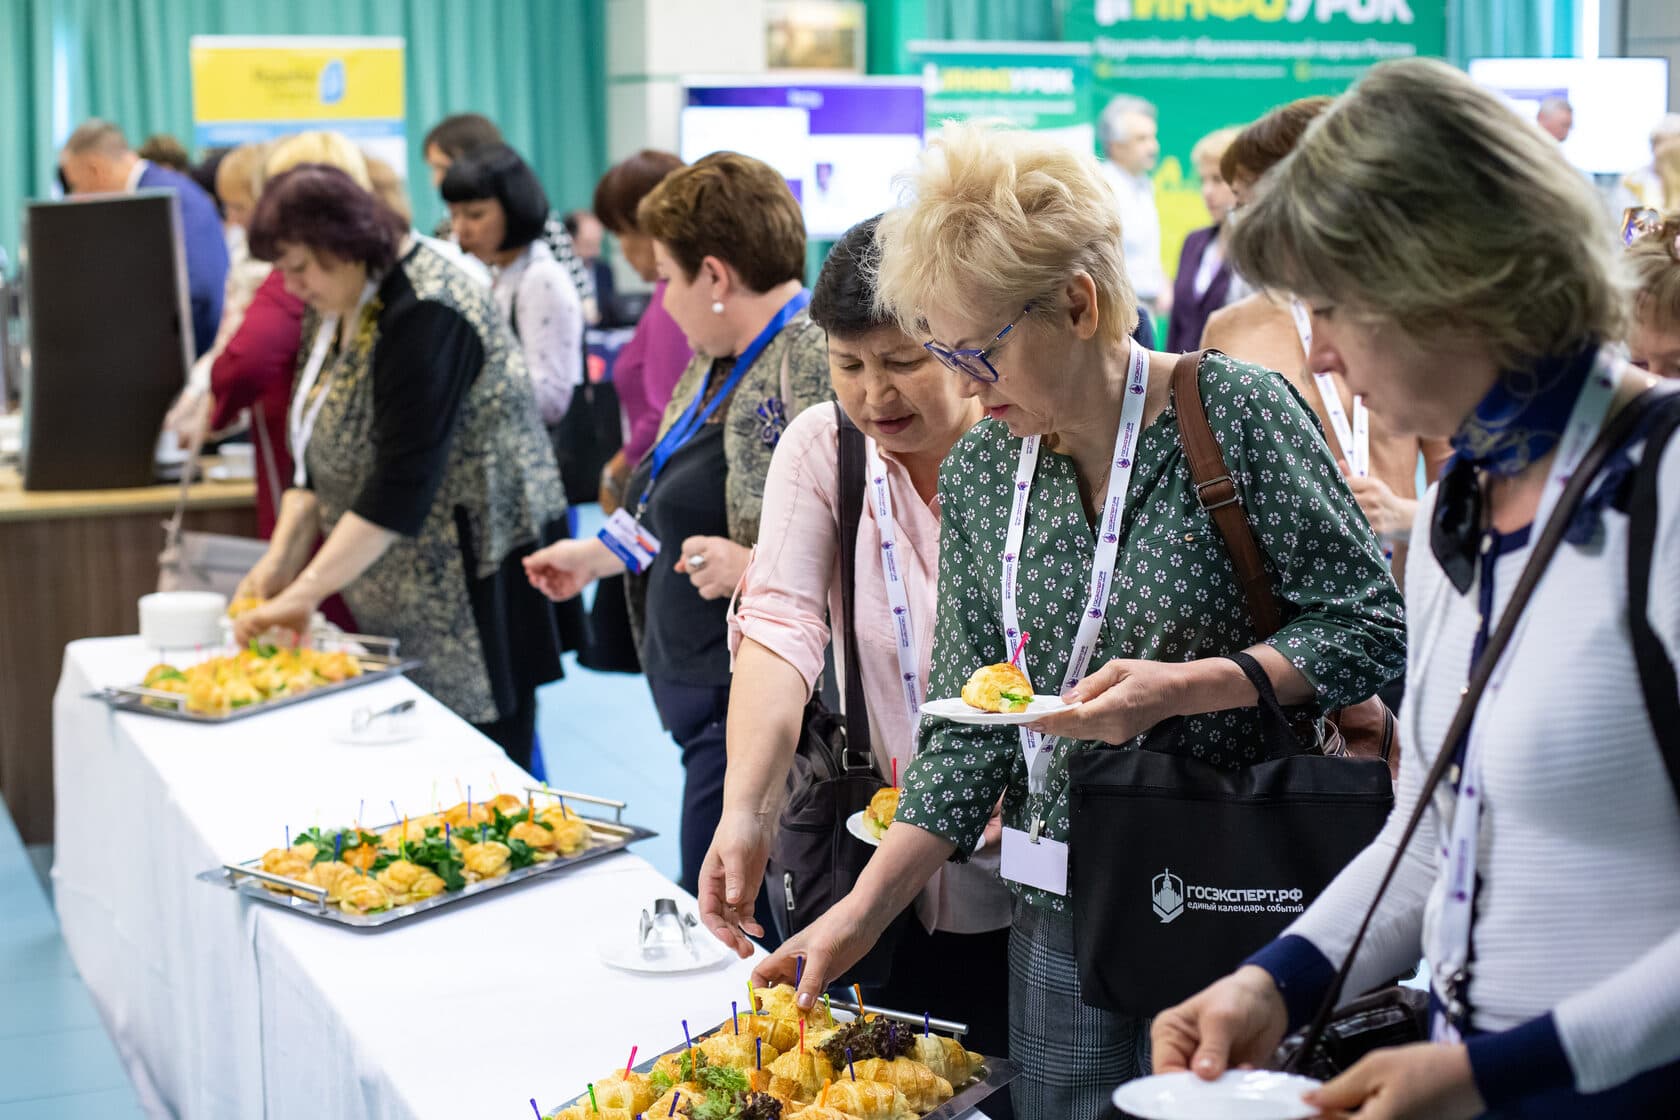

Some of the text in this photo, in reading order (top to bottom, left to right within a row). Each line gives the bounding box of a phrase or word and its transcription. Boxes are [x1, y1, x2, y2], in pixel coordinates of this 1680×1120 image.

[1186, 885, 1303, 902] ГОСЭКСПЕРТ.РФ
[1187, 901, 1304, 914] единый календарь событий
